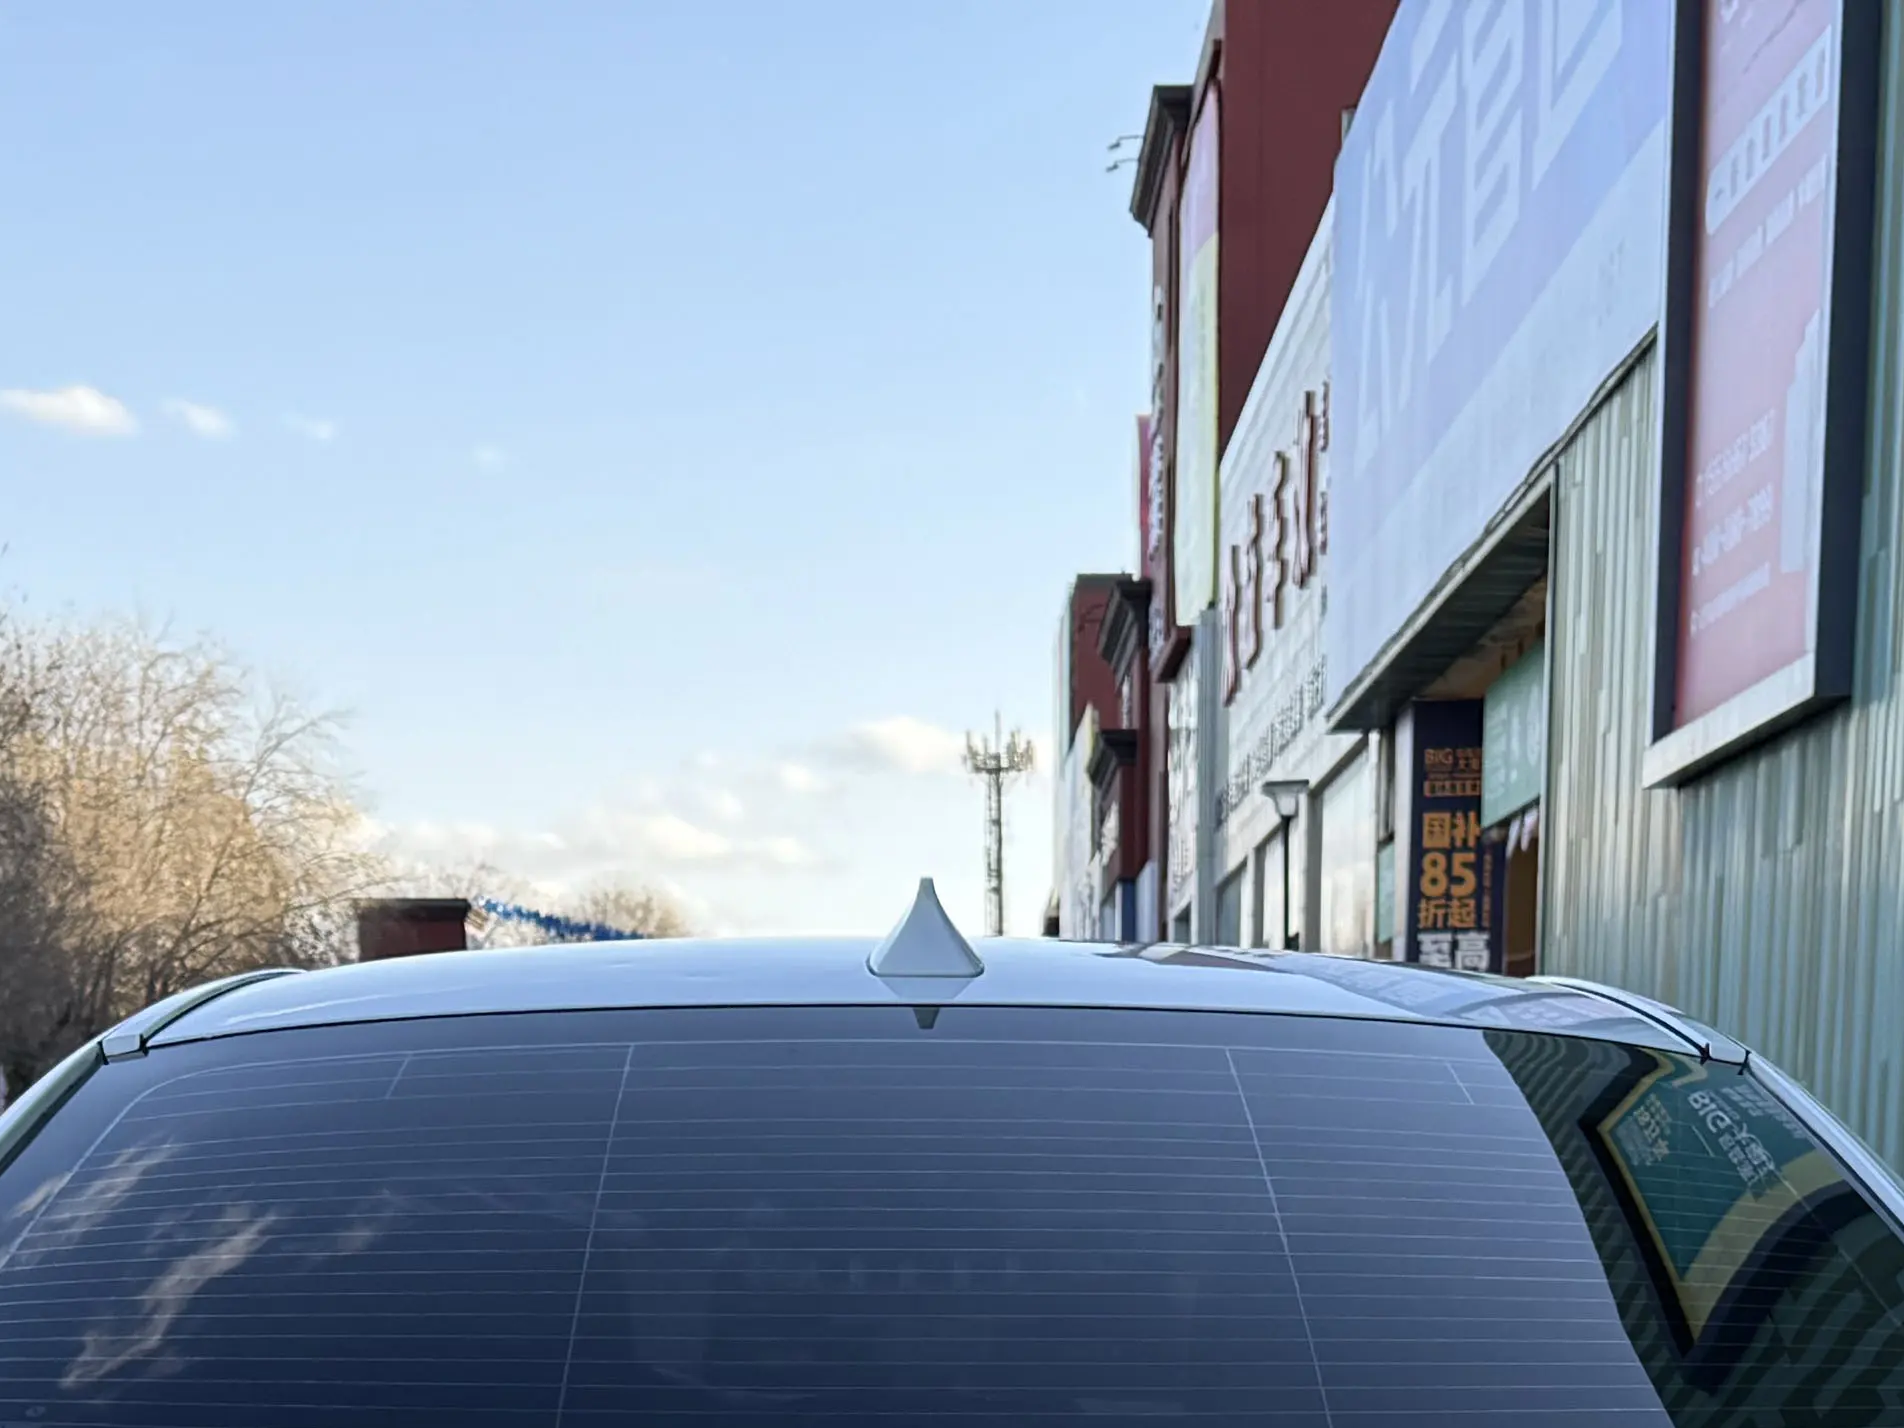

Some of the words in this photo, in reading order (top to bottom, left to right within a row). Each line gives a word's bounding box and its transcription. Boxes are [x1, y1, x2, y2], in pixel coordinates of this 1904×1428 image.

[1422, 810, 1481, 849] 国补
[1420, 852, 1478, 898] 85
[1417, 898, 1477, 929] 折起
[1417, 931, 1491, 972] 至高
